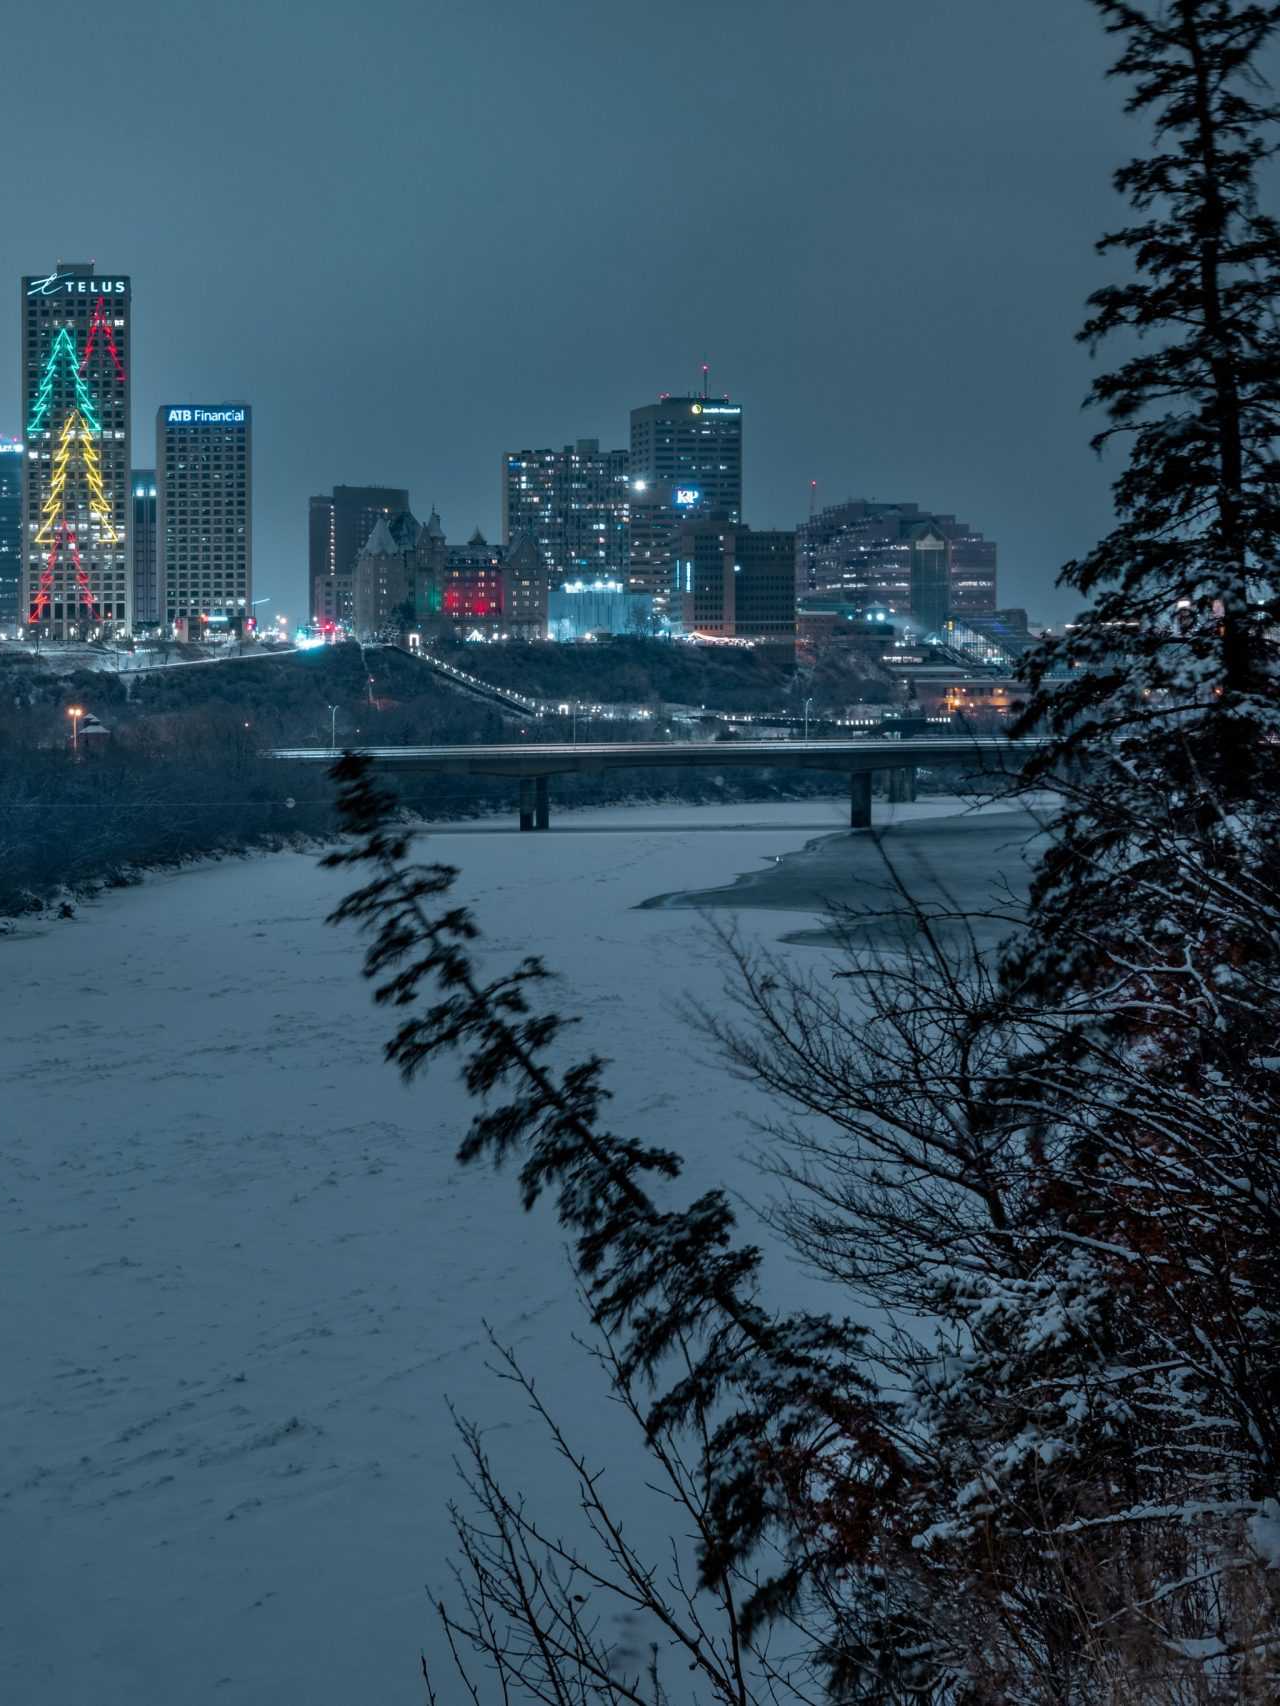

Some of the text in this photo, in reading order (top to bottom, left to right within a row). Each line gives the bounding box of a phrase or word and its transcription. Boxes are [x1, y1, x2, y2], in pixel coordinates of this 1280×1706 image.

[65, 281, 125, 293] TELUS
[168, 409, 245, 422] ATB Financial
